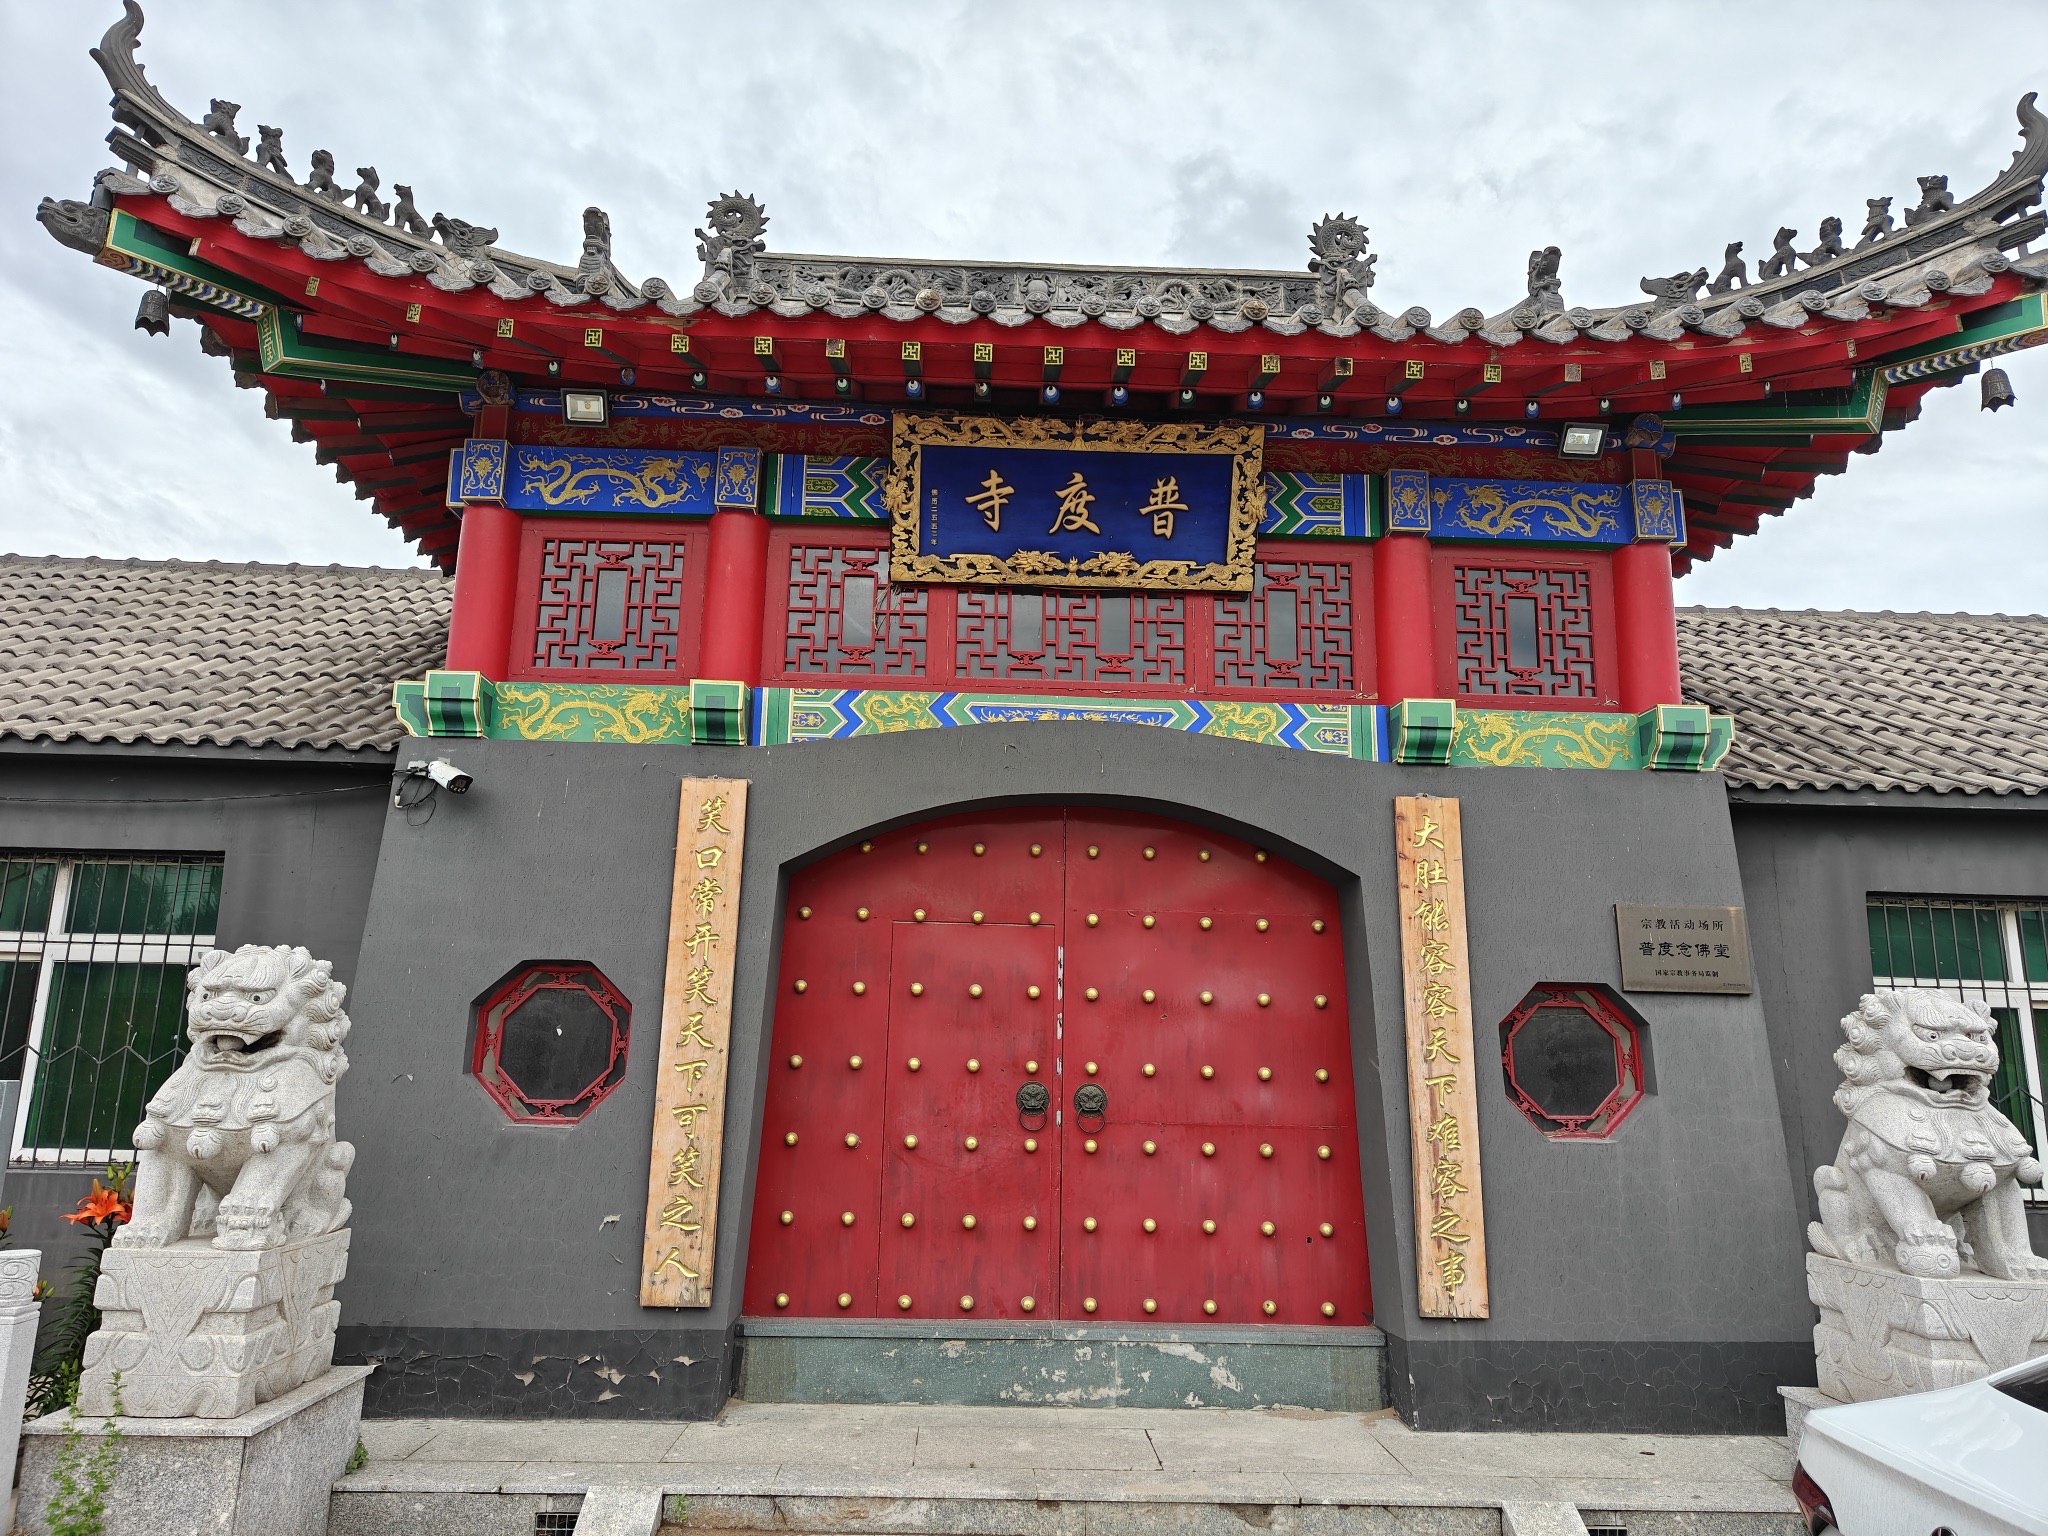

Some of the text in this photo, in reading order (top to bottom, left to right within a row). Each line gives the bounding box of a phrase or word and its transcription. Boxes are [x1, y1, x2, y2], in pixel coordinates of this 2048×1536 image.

[965, 469, 1189, 540] 普度寺
[1640, 918, 1724, 932] 宗教活动场所
[1638, 941, 1731, 959] 普度念佛堂
[1655, 969, 1719, 978] 国家宗教事务局监制
[654, 795, 731, 1278] 笑口常开笑天下可笑之人
[1412, 814, 1471, 1297] 大肚能容容天下难容之事
